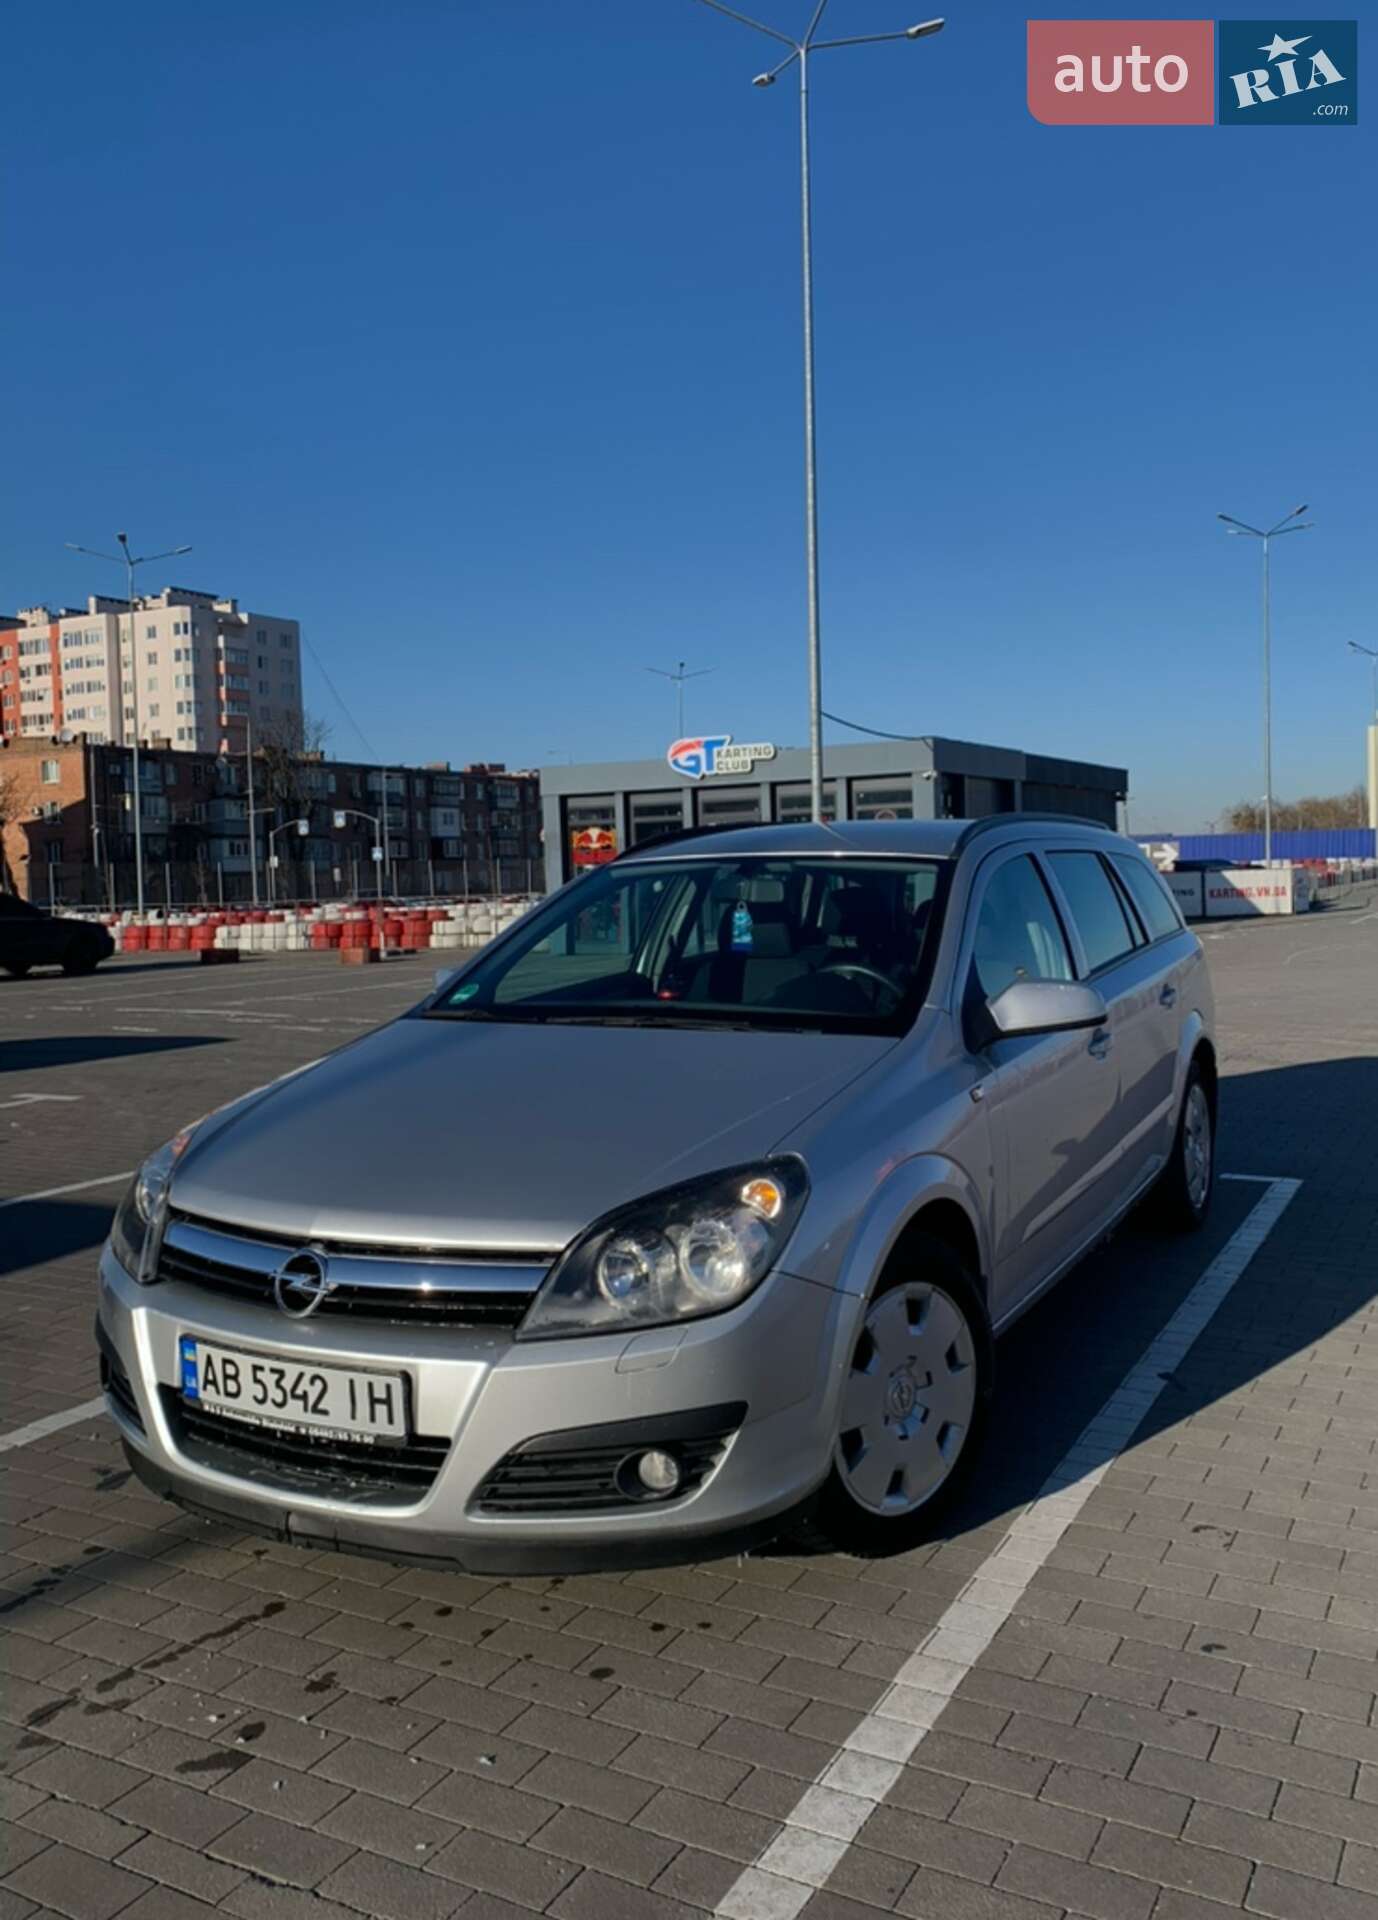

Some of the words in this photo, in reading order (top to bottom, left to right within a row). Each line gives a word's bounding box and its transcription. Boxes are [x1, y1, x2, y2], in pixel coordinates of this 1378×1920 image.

[670, 739, 727, 776] GT
[716, 746, 772, 759] KARTING
[716, 760, 750, 771] CLUB
[202, 1353, 242, 1399] AB
[252, 1364, 330, 1416] 5342
[349, 1378, 394, 1425] IH
